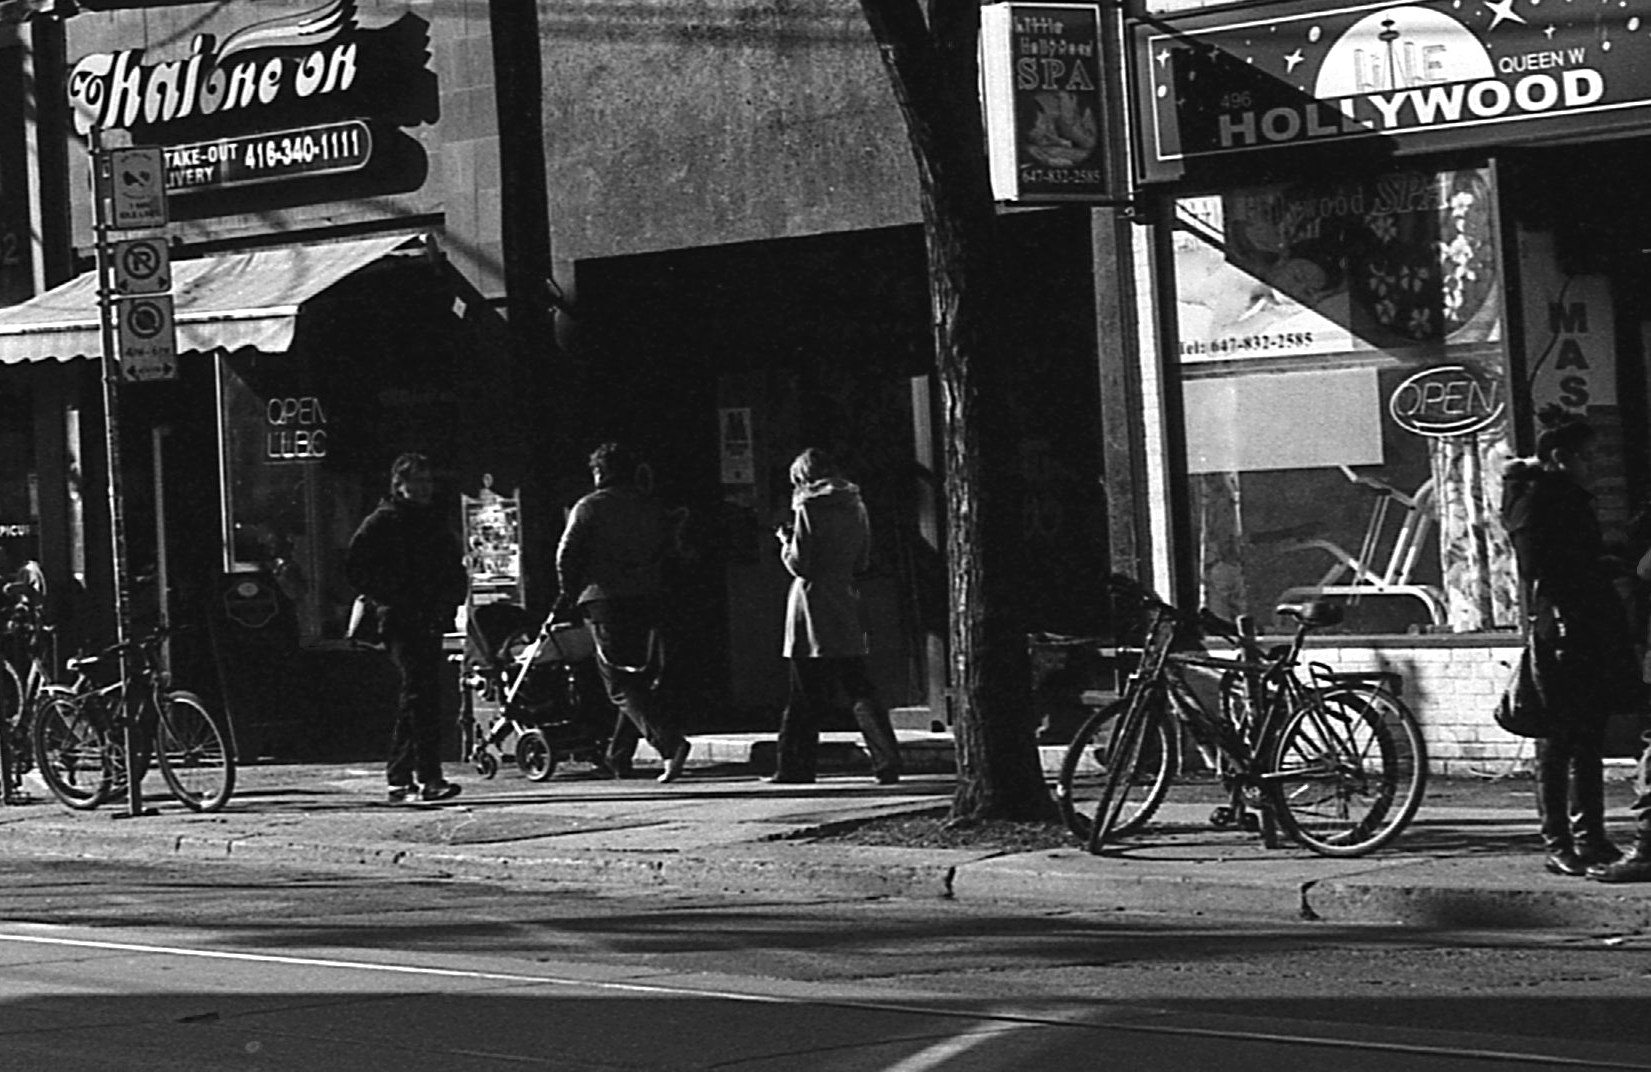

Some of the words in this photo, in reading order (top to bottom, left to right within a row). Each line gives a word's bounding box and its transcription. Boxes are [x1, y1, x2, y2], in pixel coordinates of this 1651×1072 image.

[1017, 56, 1096, 91] SPA
[1499, 52, 1563, 74] QUEEN
[1564, 47, 1586, 65] W
[68, 33, 202, 136] Thai
[1221, 92, 1250, 110] 496
[1218, 67, 1605, 148] HOLLYWOOD
[163, 143, 239, 169] TAKE-OUT
[244, 129, 360, 170] 416-340-1111
[1209, 332, 1314, 352] 647-832-2585
[268, 397, 327, 425] OPEN
[1396, 380, 1497, 416] OPEN
